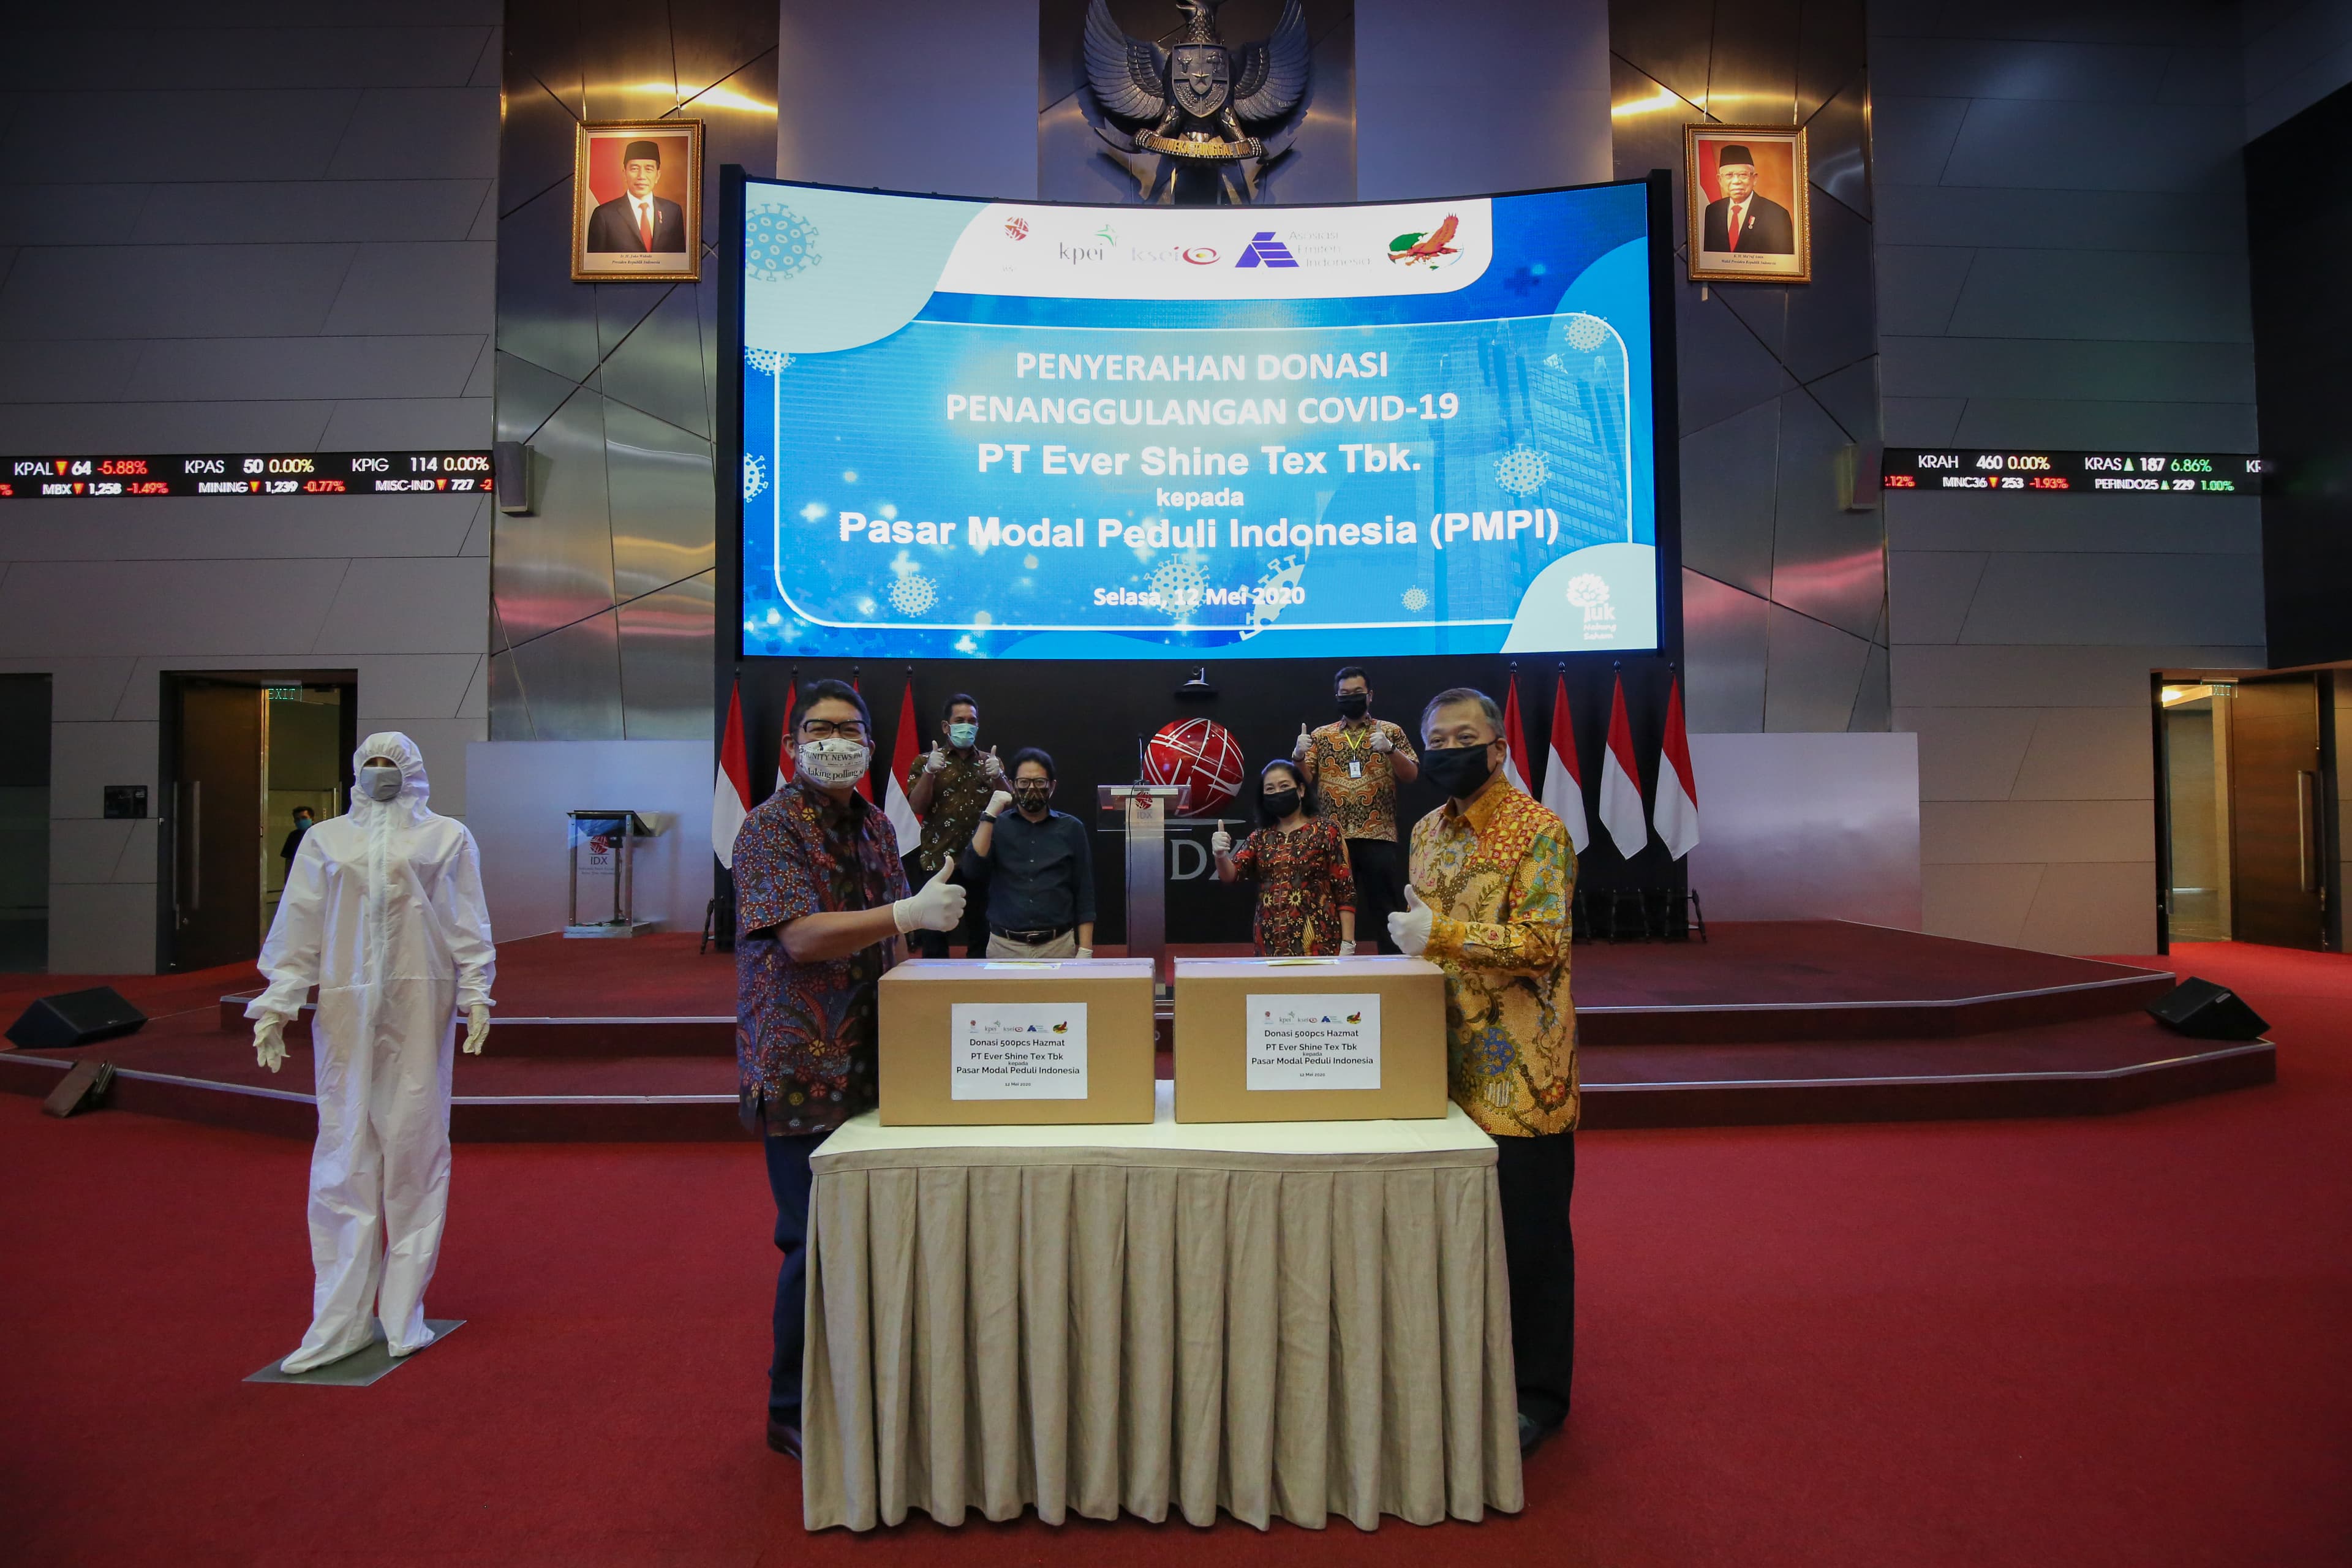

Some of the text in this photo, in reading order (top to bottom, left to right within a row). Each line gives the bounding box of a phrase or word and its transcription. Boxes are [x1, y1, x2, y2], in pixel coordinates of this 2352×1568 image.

[1194, 143, 1233, 156] TUNGGAL
[1060, 242, 1103, 265] kpei
[1016, 351, 1388, 382] PENYERAHAN DONASI
[946, 392, 1459, 425] PENANGGULANGAN COVID-19
[185, 458, 315, 474] KPAS 50 0.00%
[352, 456, 490, 472] KPIG 114 0.00%
[978, 443, 1422, 476] PT Ever Shine Tex Tbk.
[1918, 455, 2051, 470] KRAH 460 0.00%
[2084, 457, 2212, 472] KRAS 187 6.86%
[14, 460, 148, 476] KPAL 64 -5.88%
[42, 483, 72, 496] MBX
[198, 481, 249, 494] MINING
[375, 479, 435, 492] MISC-IND
[2200, 480, 2235, 491] 1.00%
[1156, 488, 1245, 511] kepada
[839, 508, 1559, 550] Pasar Modal Peduli Indonesia (PMPI)
[1093, 587, 1306, 608] Selasa, 12 Mei 2020
[268, 688, 296, 700] EXIT
[833, 769, 858, 780] polling
[590, 856, 608, 865] IDX
